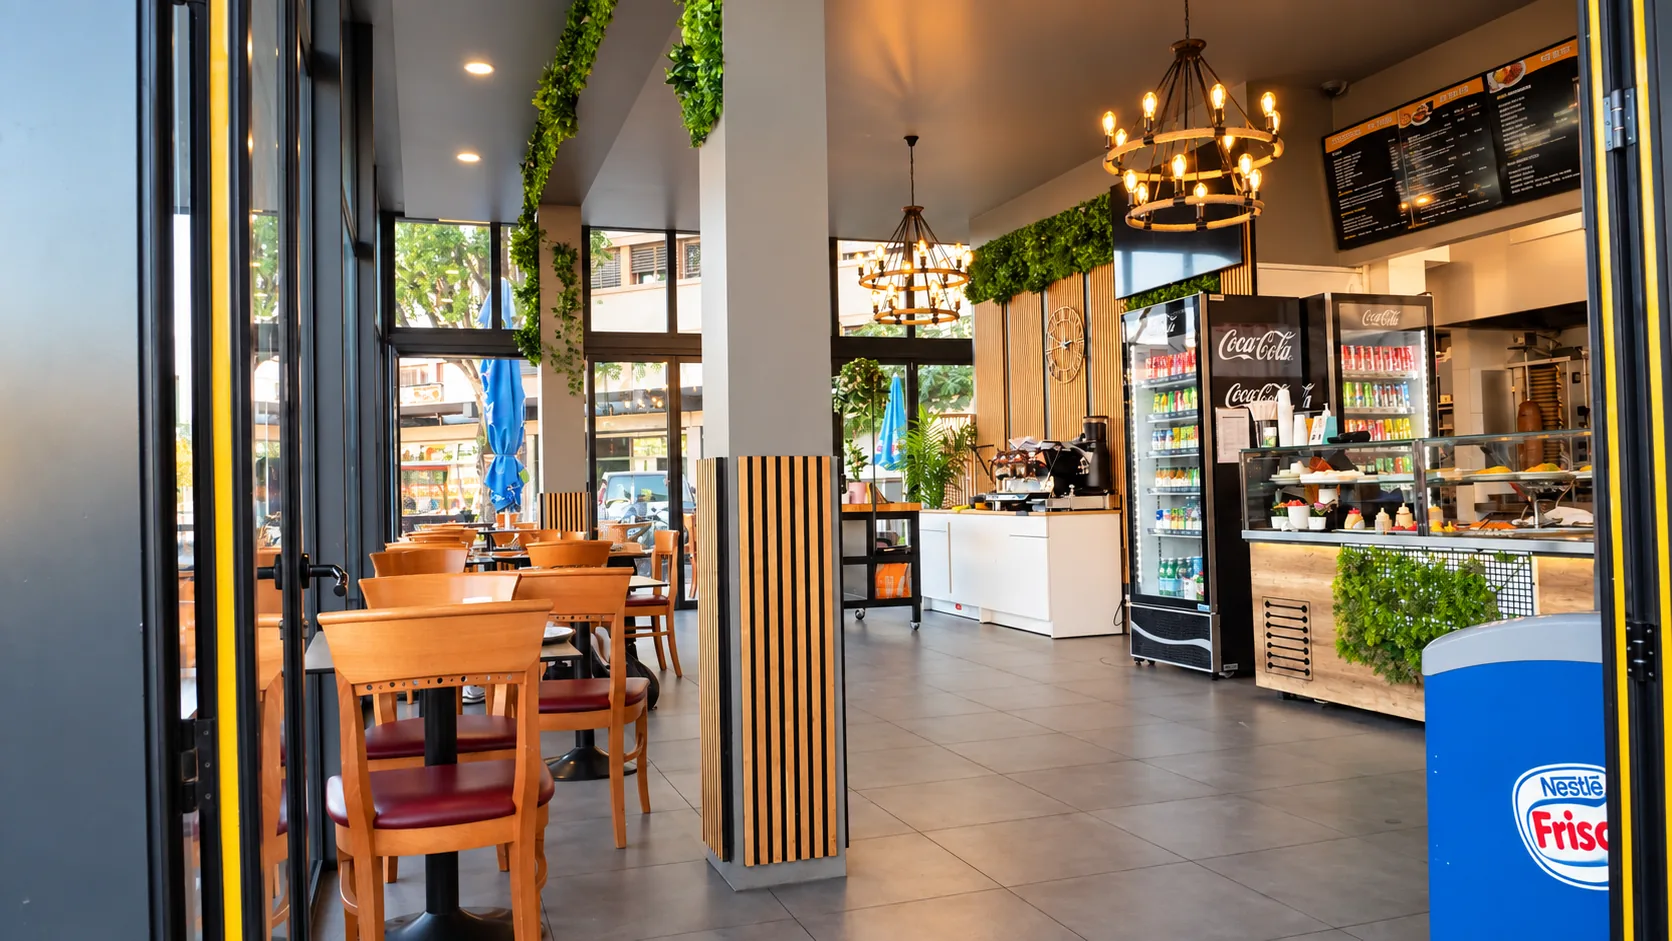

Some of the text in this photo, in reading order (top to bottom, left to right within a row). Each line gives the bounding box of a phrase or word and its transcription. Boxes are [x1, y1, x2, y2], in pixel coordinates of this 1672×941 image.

[1362, 309, 1401, 327] Coca-Cola
[1218, 329, 1296, 360] Coca-Cola
[1540, 775, 1604, 797] Nestlé
[1531, 809, 1608, 852] Frisc
